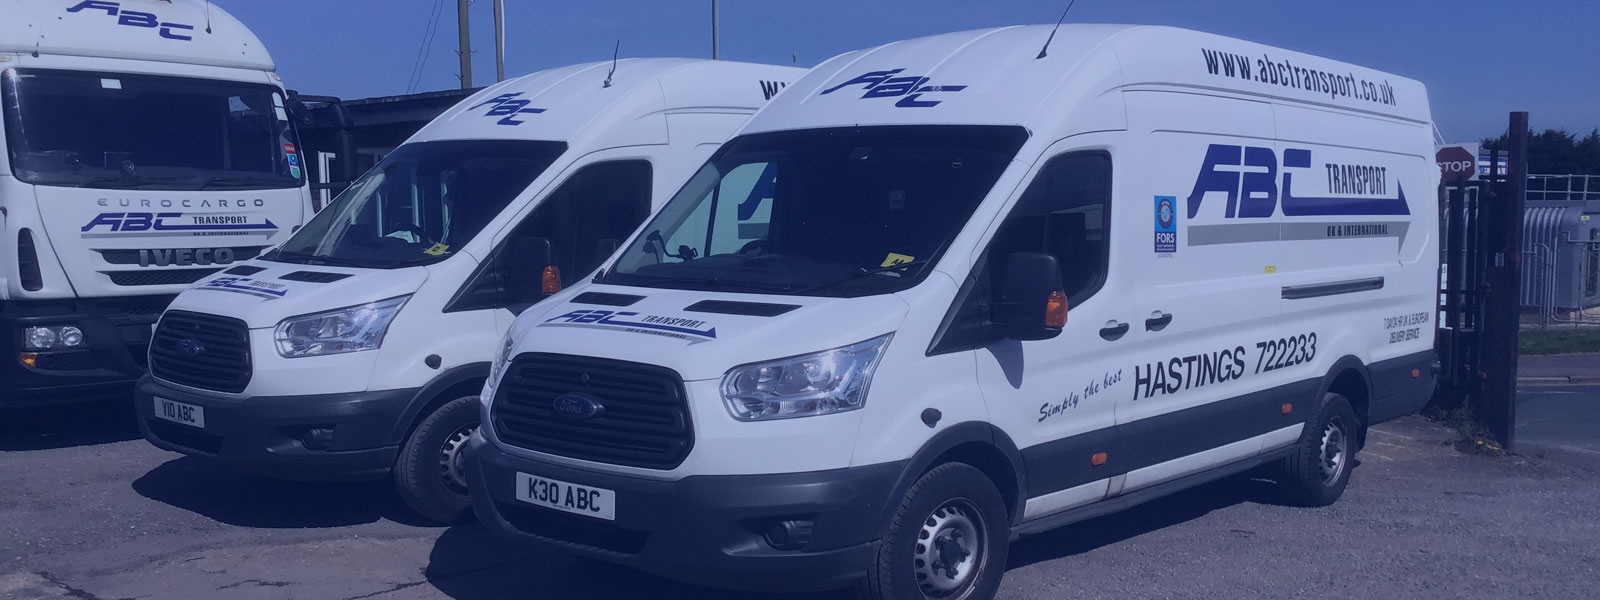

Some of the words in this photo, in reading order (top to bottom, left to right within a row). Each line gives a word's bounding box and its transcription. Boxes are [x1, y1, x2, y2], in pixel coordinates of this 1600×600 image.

[66, 0, 194, 41] ABC
[819, 68, 968, 107] ABC
[1202, 48, 1396, 107] www.abctransport.co.uk
[466, 92, 547, 125] ABC
[1187, 143, 1311, 219] ABC
[1325, 163, 1386, 195] TRANSPORT
[97, 198, 264, 208] EUROCARGO
[81, 212, 183, 232] ABC
[192, 216, 247, 224] TRANSPORT
[1327, 225, 1336, 236] UK
[1344, 224, 1388, 236] INTERNATIONAL
[1156, 232, 1175, 244] FORS
[138, 248, 234, 267] IVECO
[545, 310, 640, 324] ABC
[641, 315, 707, 328] TRANSPORT
[1412, 311, 1429, 325] EUROPEAN
[1389, 330, 1405, 344] DELIVERY
[1405, 328, 1420, 341] SERVICE
[1133, 346, 1246, 400] HASTINGS
[1254, 332, 1317, 374] 722233
[1038, 391, 1079, 422] Simply
[1084, 379, 1100, 400] the
[1103, 368, 1122, 389] best
[177, 404, 196, 422] ABC
[528, 477, 559, 504] K30
[565, 486, 600, 512] ABC
